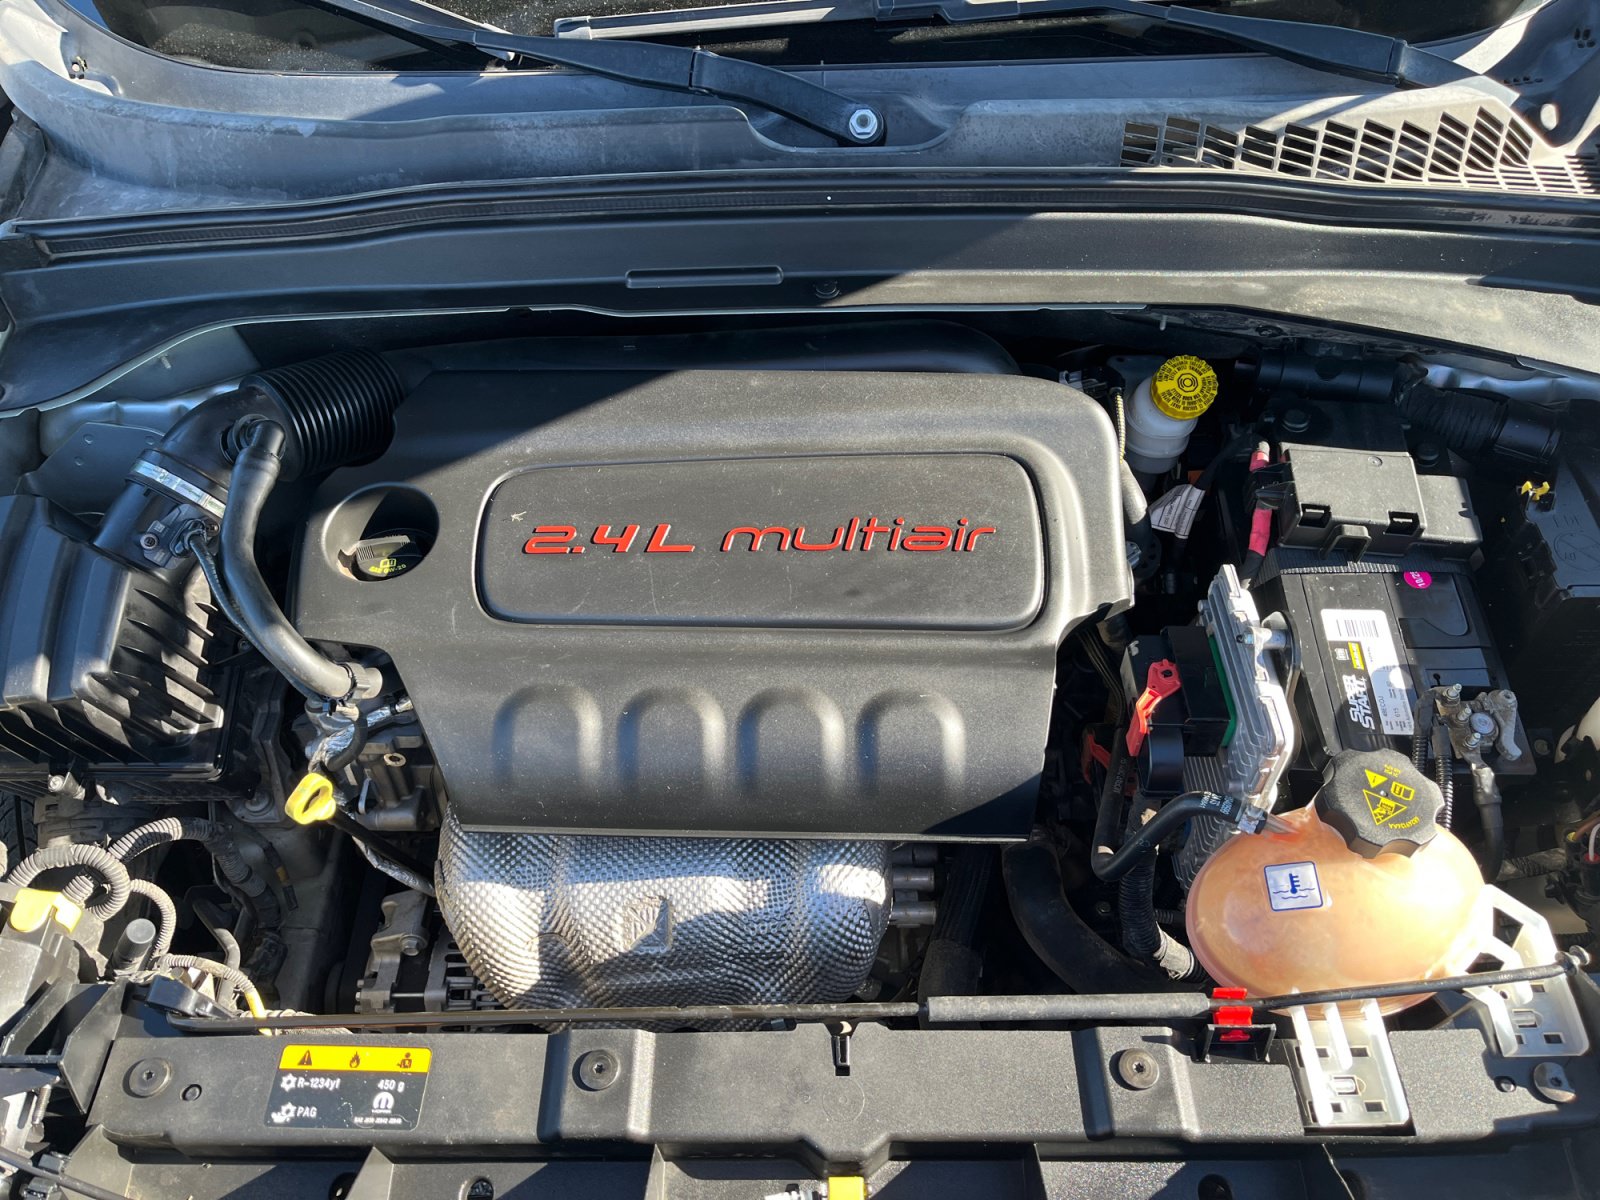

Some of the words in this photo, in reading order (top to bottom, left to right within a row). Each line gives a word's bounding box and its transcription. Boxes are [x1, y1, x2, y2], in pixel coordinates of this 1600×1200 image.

[719, 517, 997, 552] multiair
[1342, 674, 1363, 723] SUPER
[297, 1078, 341, 1091] R-1234yf
[378, 1079, 396, 1091] 450
[397, 1082, 405, 1092] g
[296, 1106, 317, 1118] PAG
